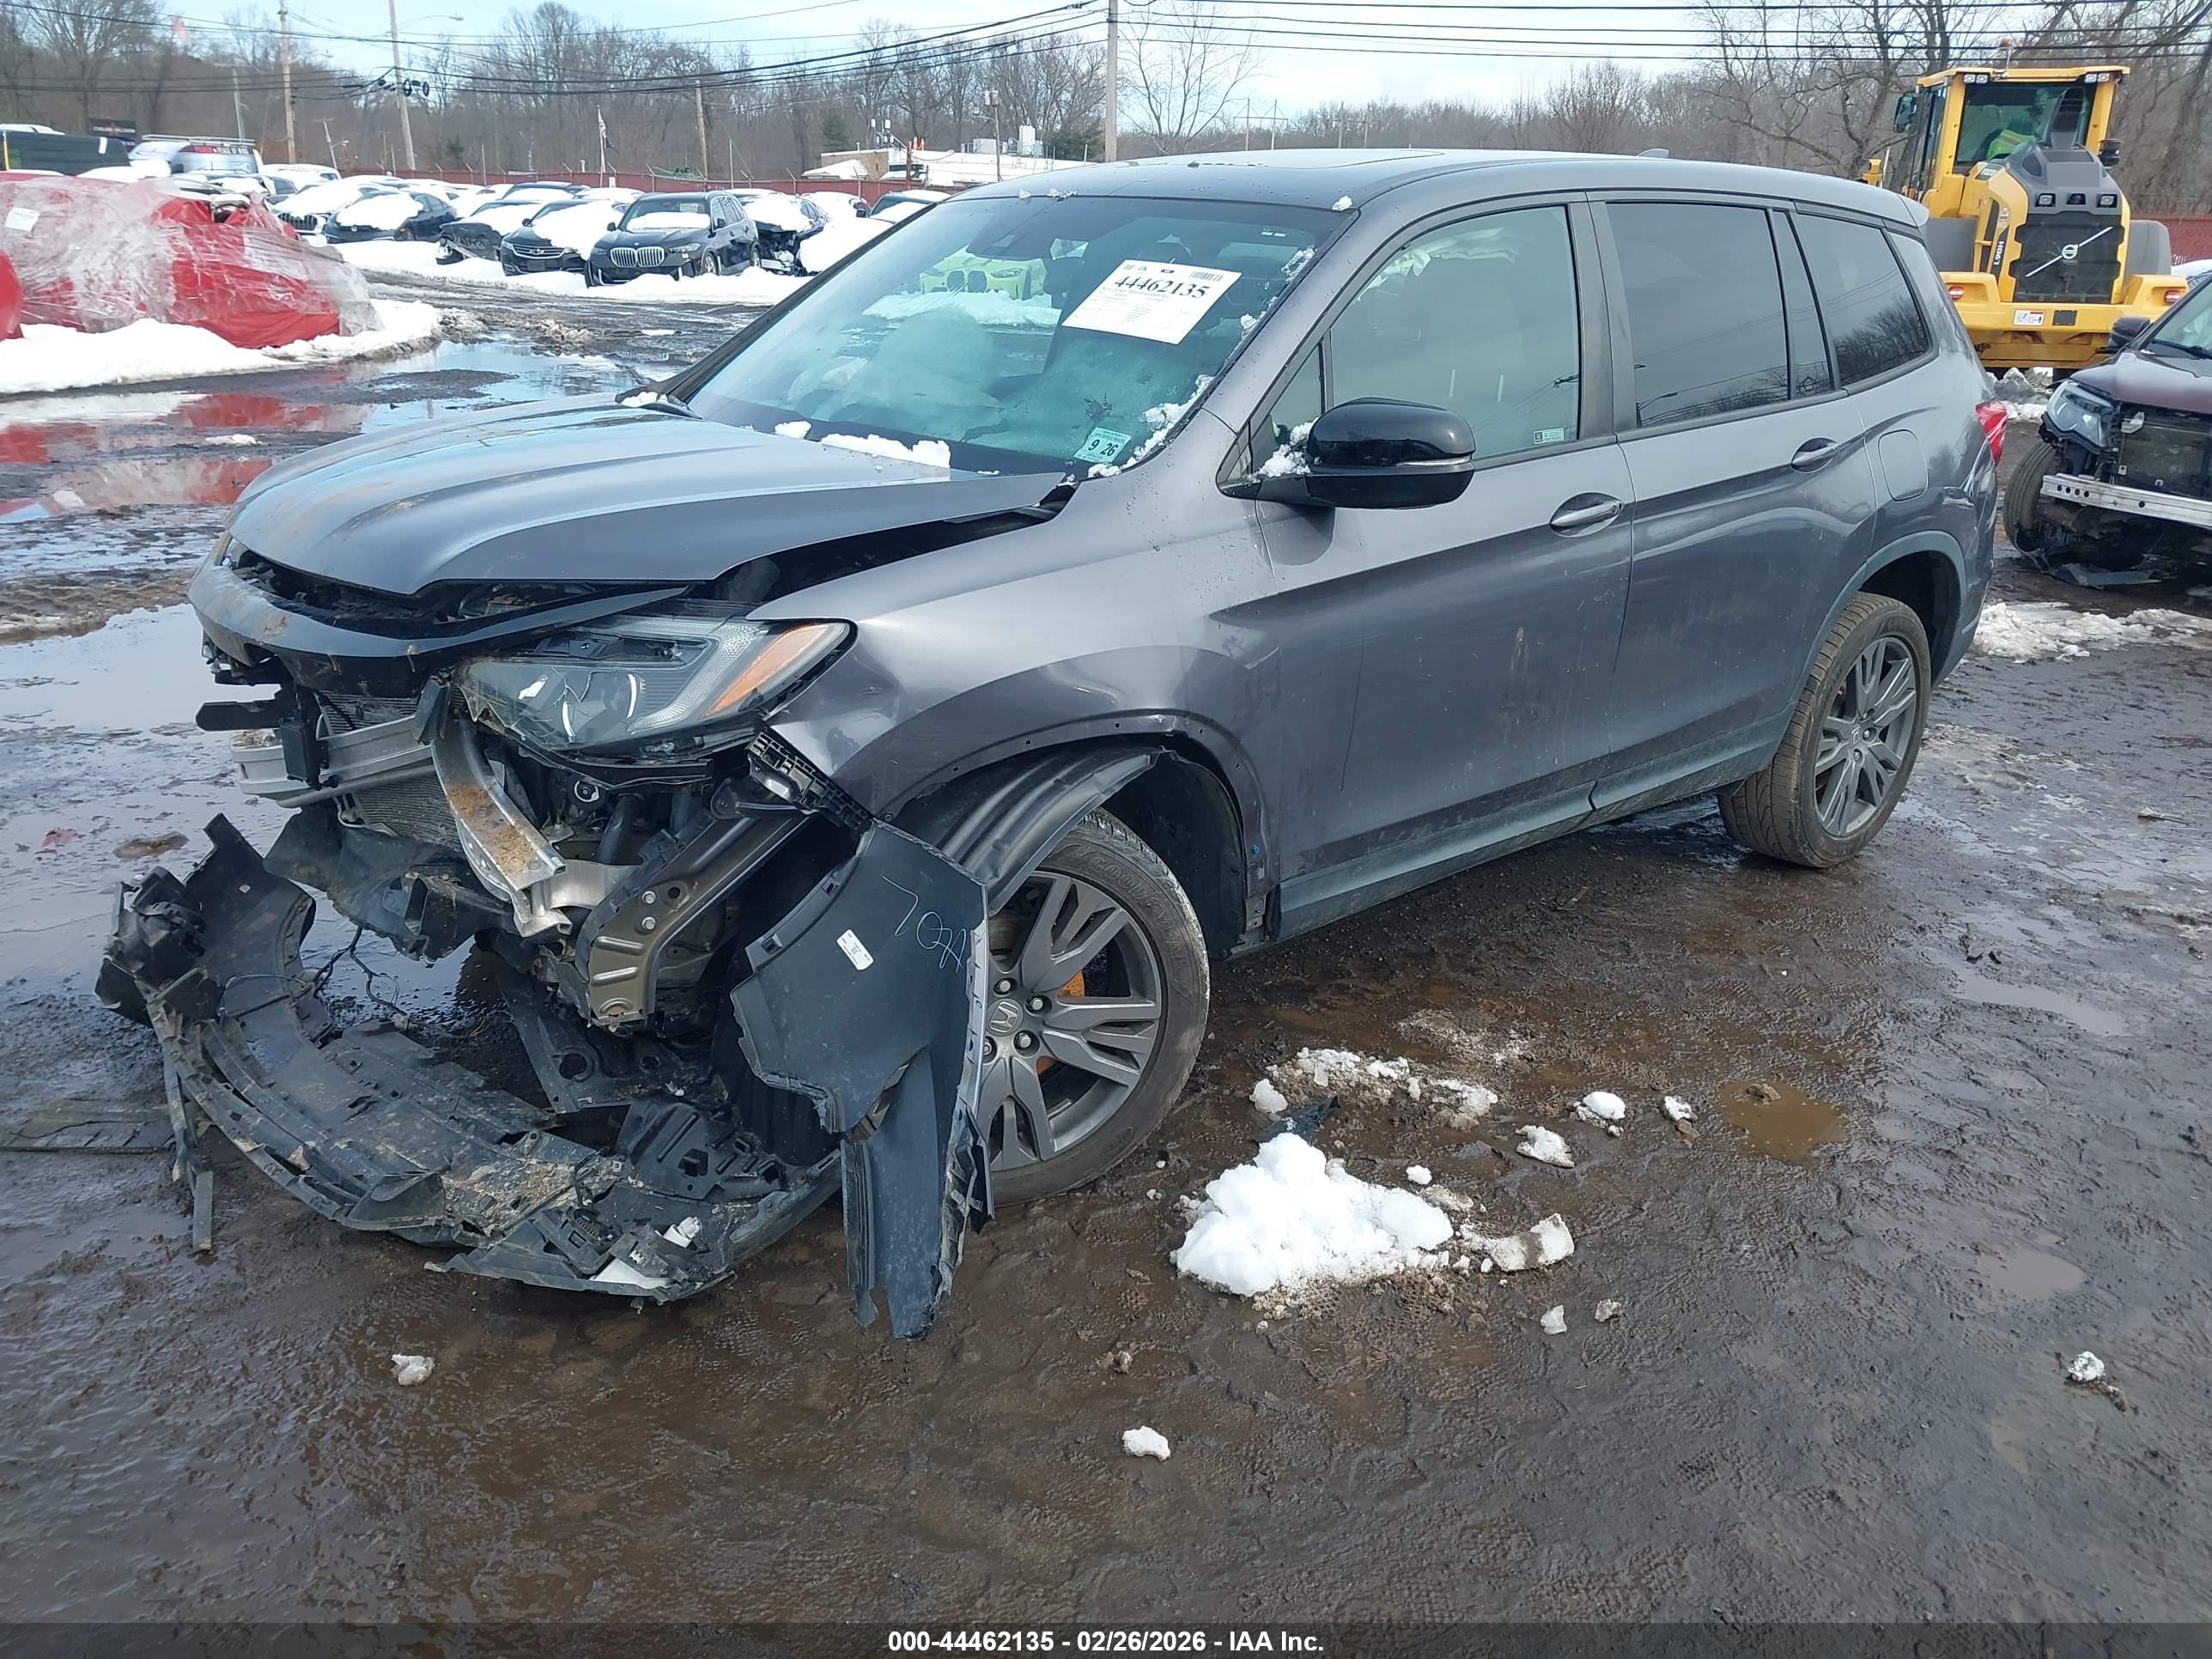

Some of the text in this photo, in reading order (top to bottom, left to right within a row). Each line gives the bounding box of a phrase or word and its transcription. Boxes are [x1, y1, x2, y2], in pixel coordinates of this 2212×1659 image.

[1115, 276, 1210, 298] 44462135
[1088, 439, 1119, 456] 9 26
